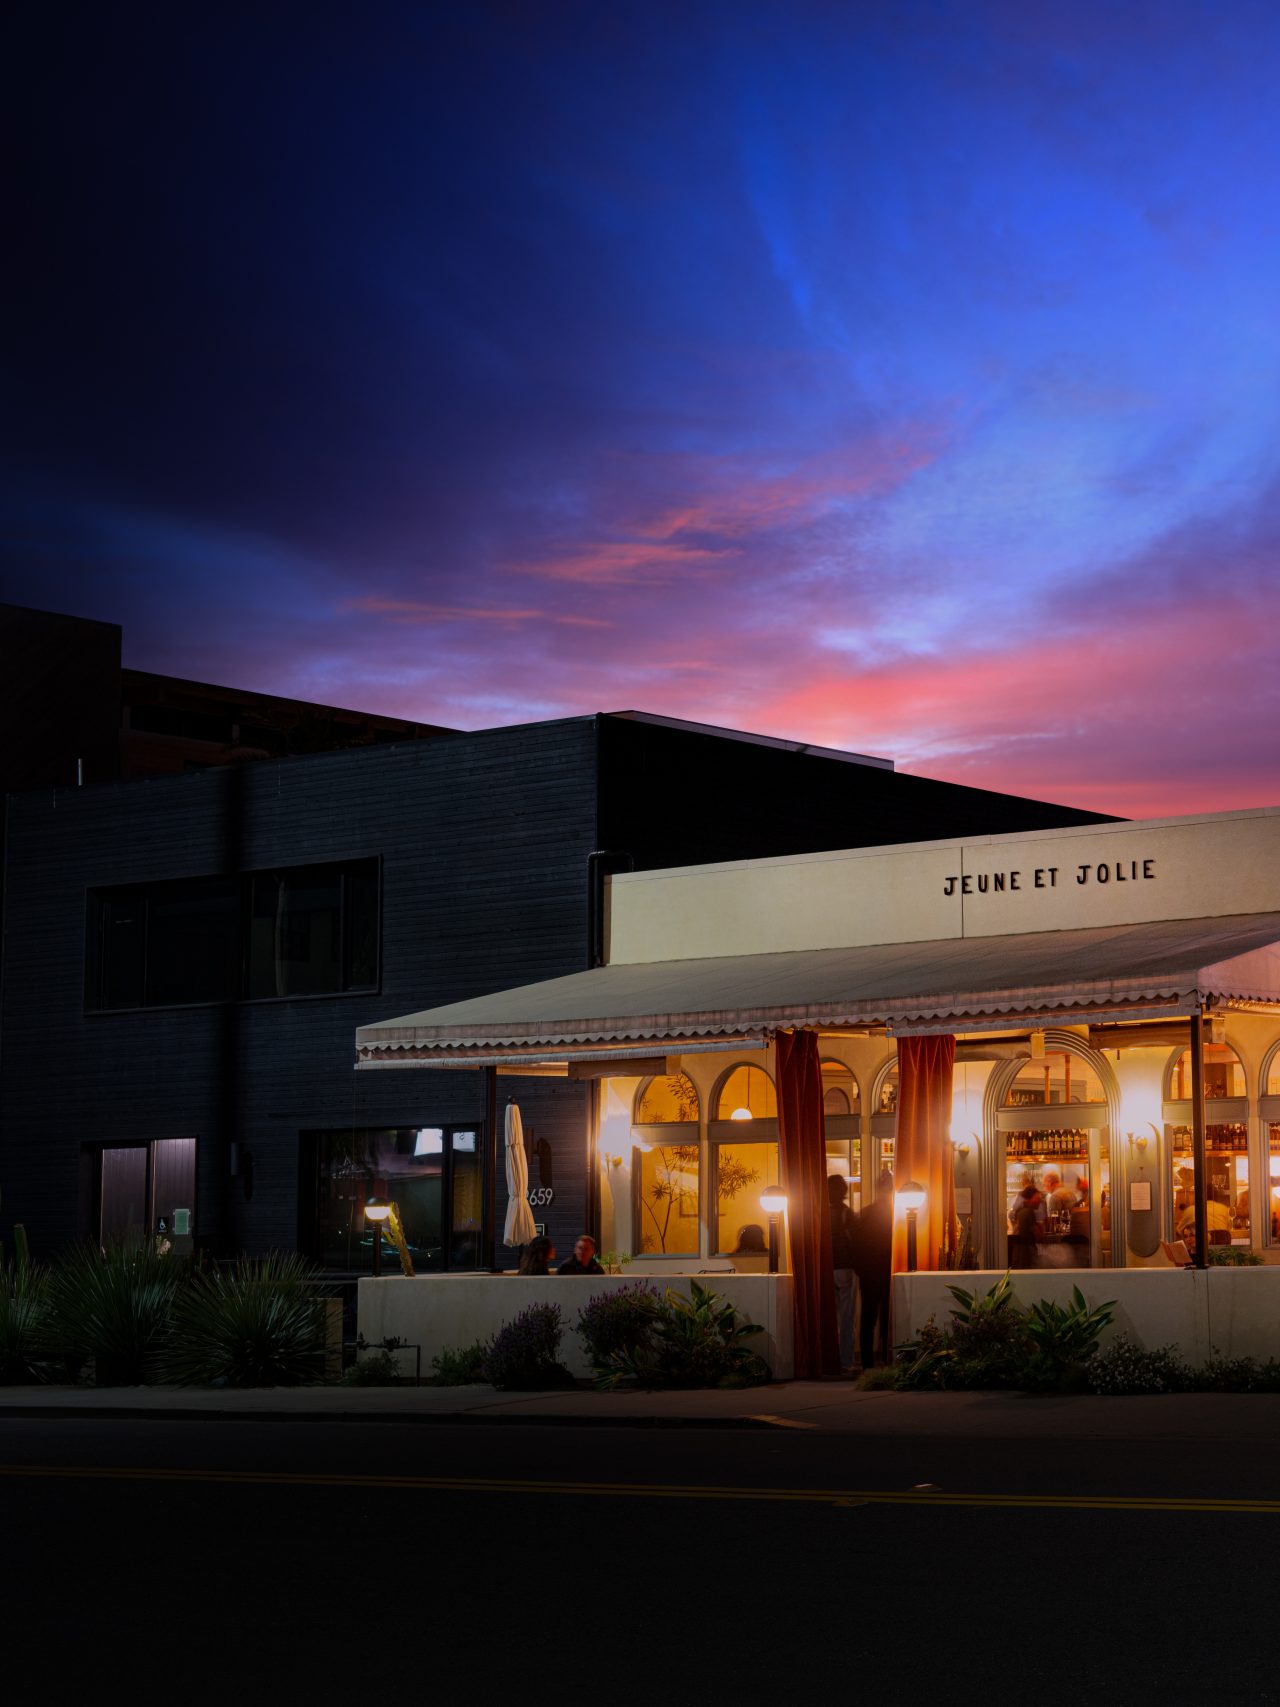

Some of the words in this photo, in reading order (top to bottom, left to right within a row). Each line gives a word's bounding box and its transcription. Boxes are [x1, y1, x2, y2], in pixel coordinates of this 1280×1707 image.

[943, 871, 1020, 896] JEUNE
[1034, 867, 1058, 888] ET
[1076, 859, 1155, 885] JOLIE
[526, 1188, 553, 1205] 659
